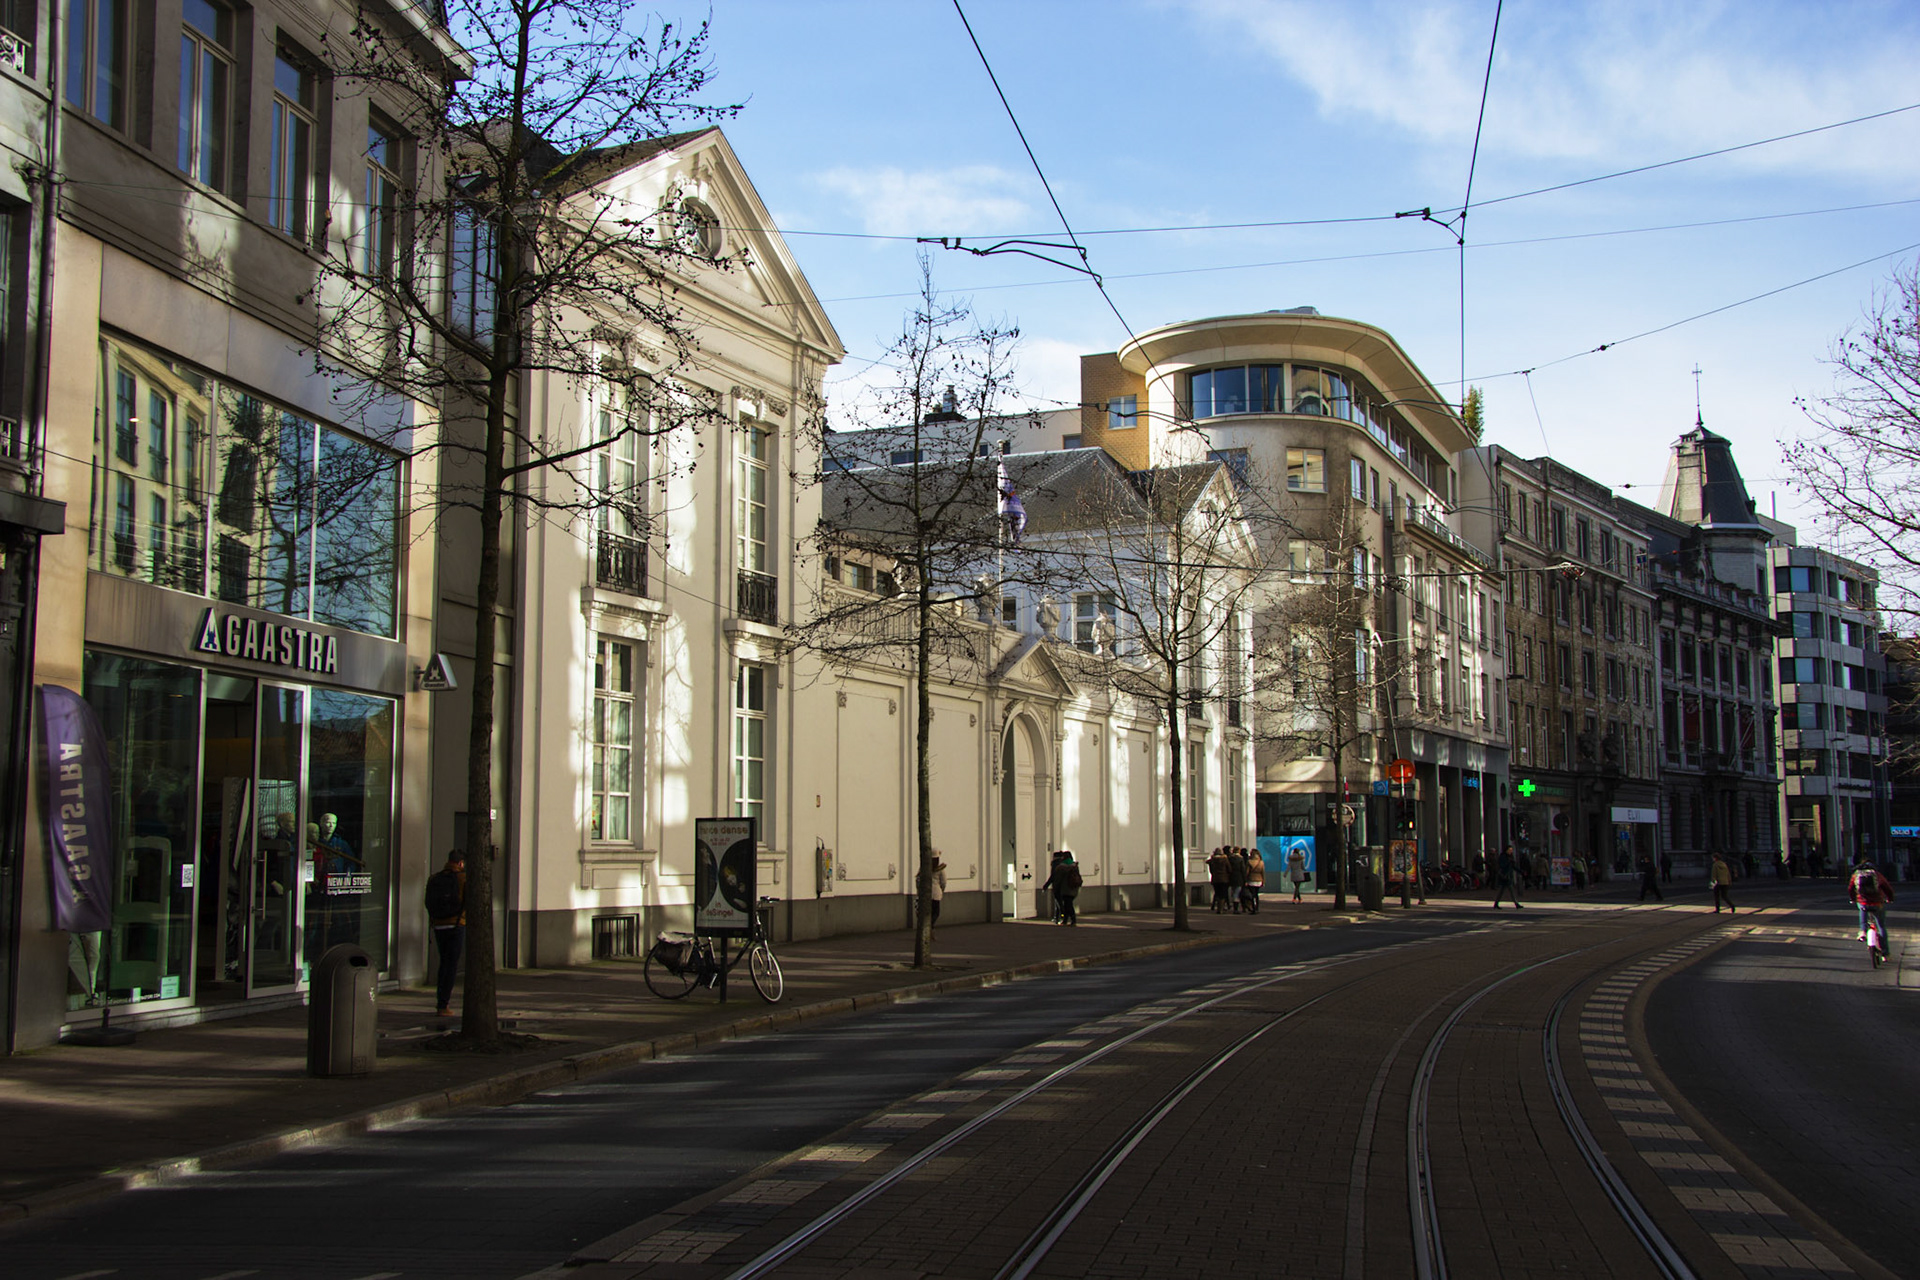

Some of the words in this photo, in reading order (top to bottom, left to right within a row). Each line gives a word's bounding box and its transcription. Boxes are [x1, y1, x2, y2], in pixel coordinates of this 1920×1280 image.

[226, 614, 338, 674] GAASTRA
[327, 877, 343, 886] NEW
[343, 877, 352, 886] IN
[352, 876, 372, 886] STORE
